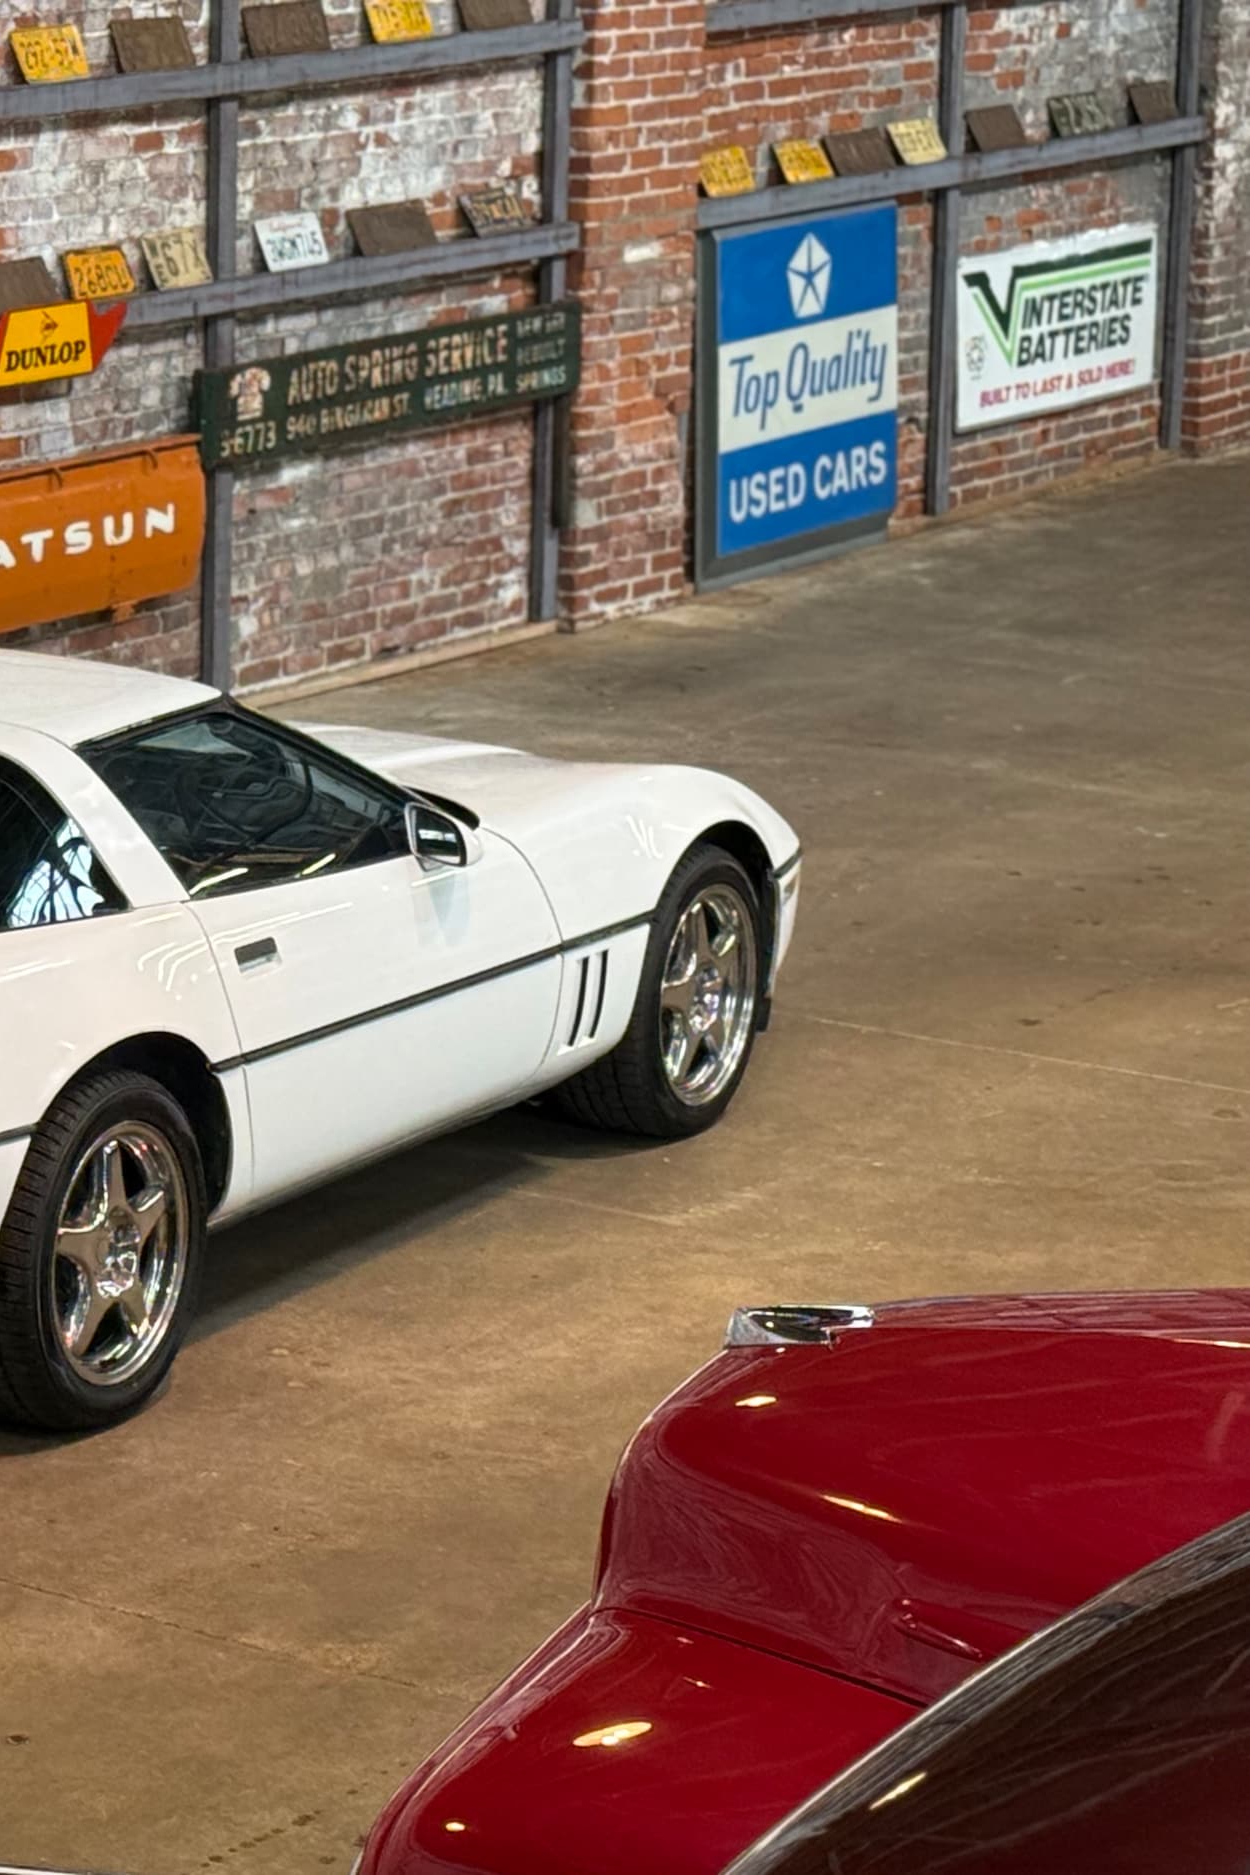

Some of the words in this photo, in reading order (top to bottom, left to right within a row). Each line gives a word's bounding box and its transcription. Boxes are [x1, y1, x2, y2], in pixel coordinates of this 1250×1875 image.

[1021, 274, 1146, 331] INTERSTATE
[5, 339, 87, 373] DUNLOP
[287, 360, 340, 406] AUTO
[344, 342, 417, 392] SPRING
[425, 324, 508, 377] SERVICE
[1016, 313, 1132, 369] BATTERIES
[728, 353, 779, 431] Top
[785, 328, 888, 414] Quality
[979, 386, 1011, 408] BUILT
[1015, 382, 1031, 400] TO
[1033, 376, 1063, 397] LAST
[1077, 366, 1103, 388] SOLD
[729, 461, 807, 524] USED
[813, 440, 888, 501] CARS
